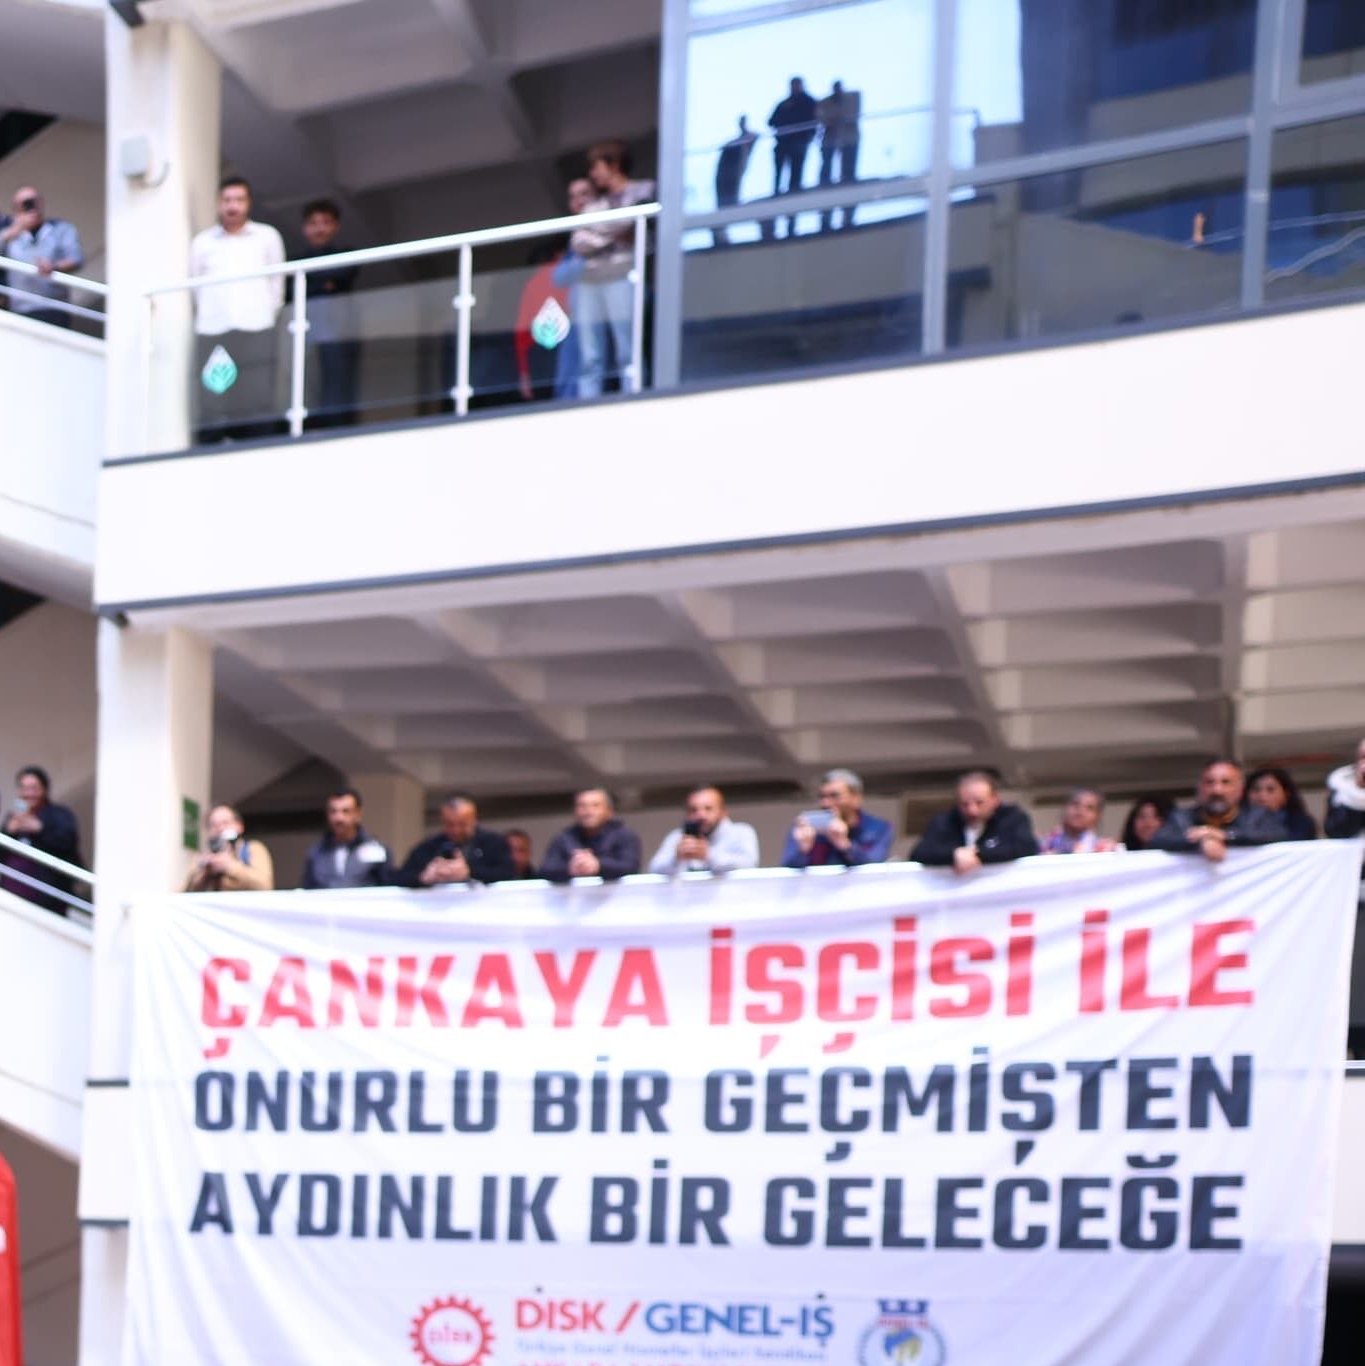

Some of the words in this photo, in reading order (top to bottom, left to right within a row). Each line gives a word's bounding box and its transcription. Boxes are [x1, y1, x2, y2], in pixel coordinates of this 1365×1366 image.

[201, 947, 669, 1059] ÇANKAYA
[709, 911, 1035, 1059] İŞÇİSİ
[1077, 909, 1256, 1015] İLE
[193, 1069, 499, 1133] ONURLU
[532, 1056, 671, 1133] BİR
[704, 1046, 1253, 1167] GEÇMİŞTEN
[189, 1171, 560, 1243] AYDINLIK
[589, 1159, 733, 1247] BİR
[763, 1154, 1245, 1252] GELECEĞE
